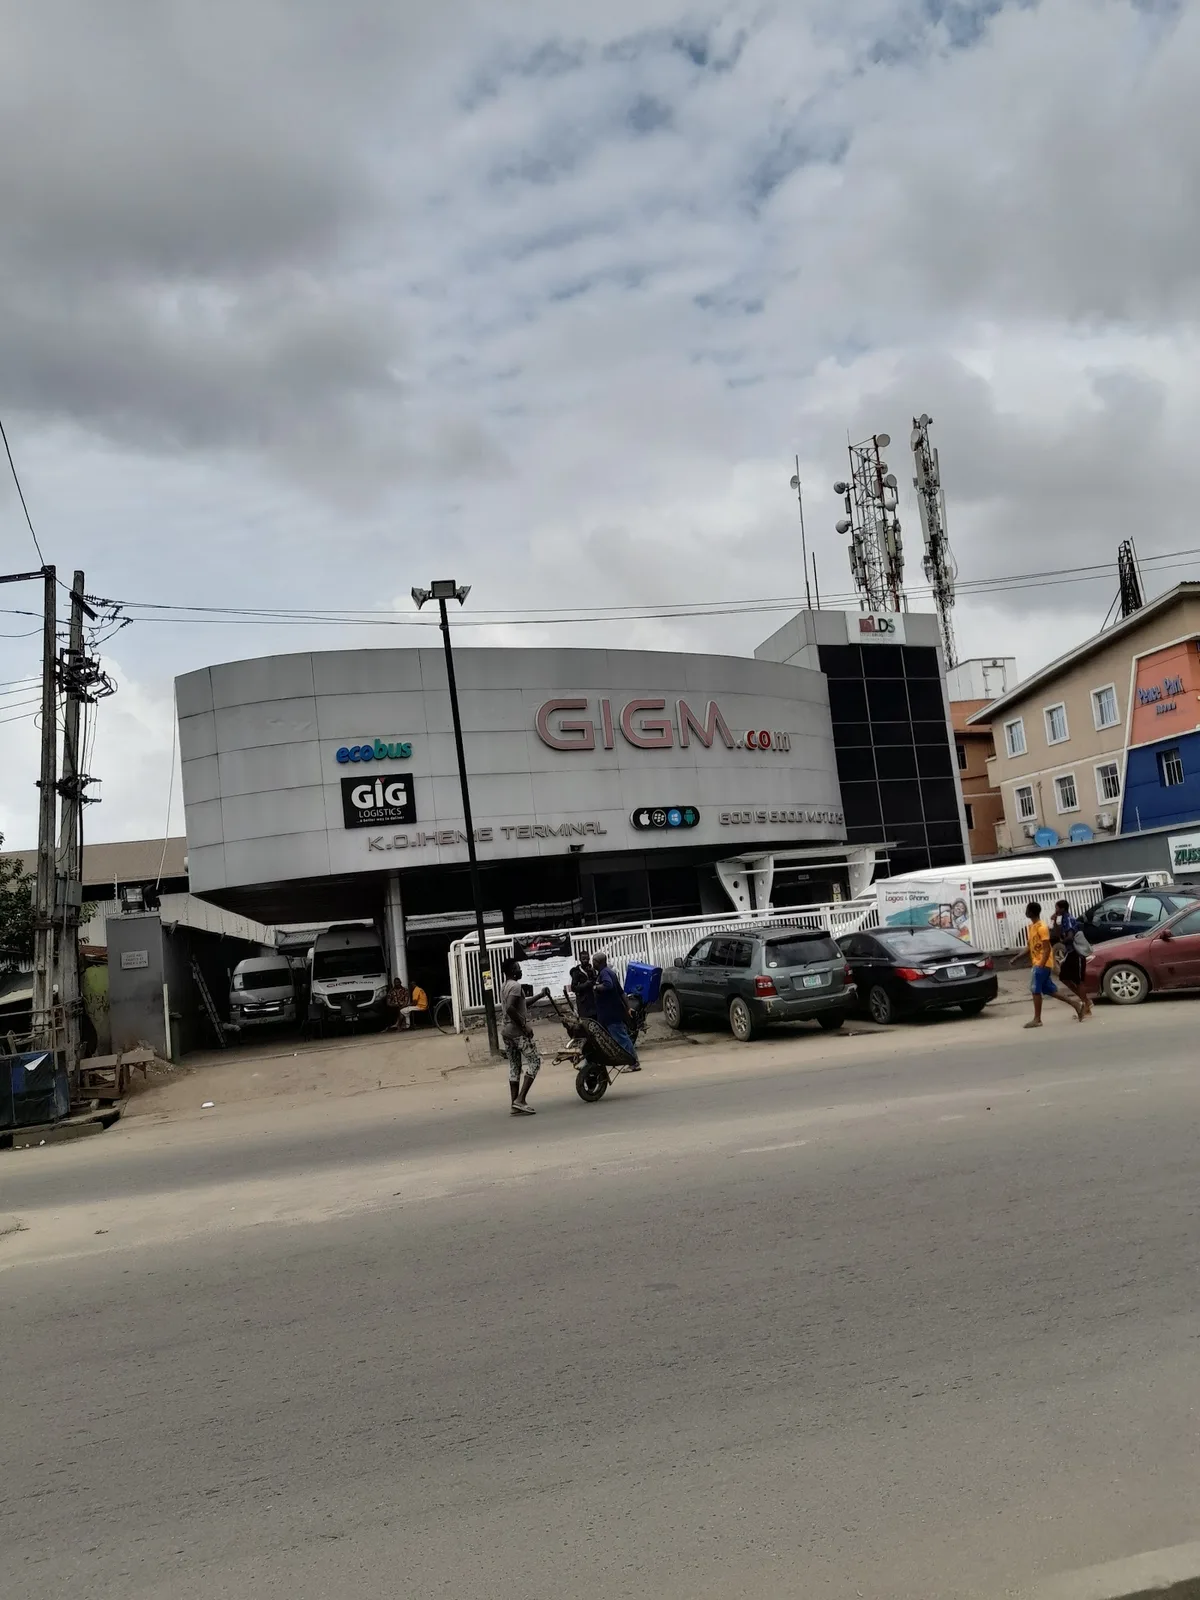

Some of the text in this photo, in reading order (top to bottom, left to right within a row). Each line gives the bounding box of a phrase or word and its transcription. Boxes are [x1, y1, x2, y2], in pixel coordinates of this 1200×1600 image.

[1137, 684, 1163, 705] Peace
[535, 697, 791, 752] GIGM.com
[336, 739, 413, 764] ecobus
[351, 778, 408, 809] GIG
[358, 807, 402, 818] LOGISTICS
[753, 810, 767, 824] IS
[500, 820, 607, 840] TERMINAL
[885, 894, 904, 904] Lagos
